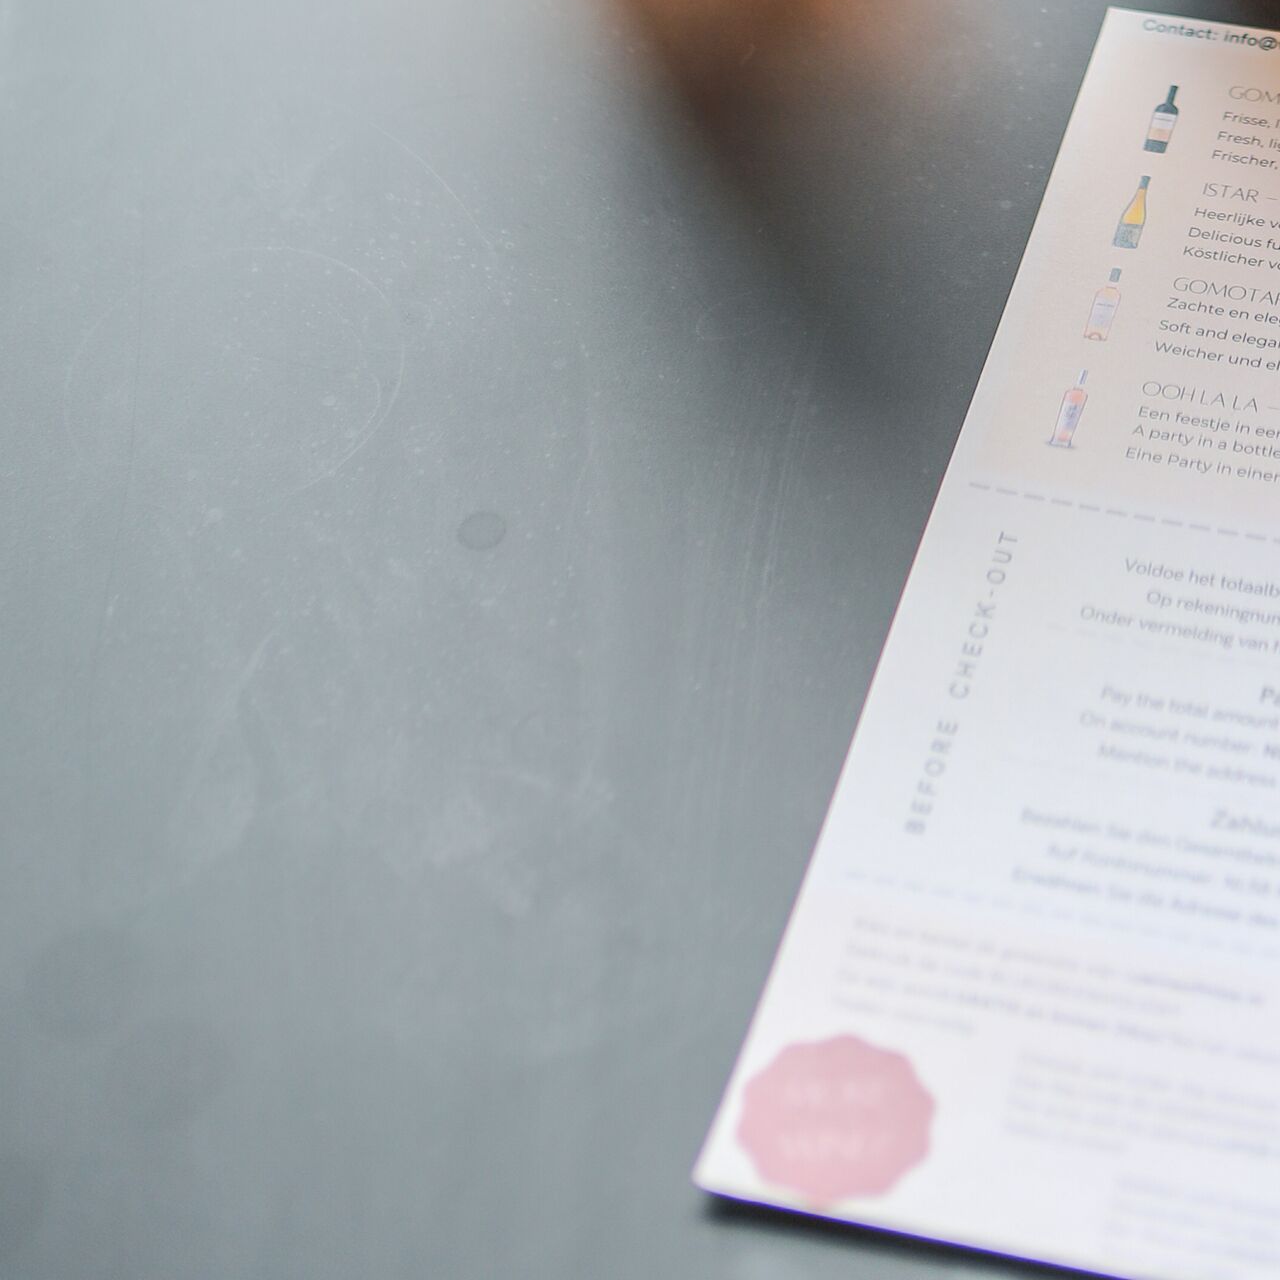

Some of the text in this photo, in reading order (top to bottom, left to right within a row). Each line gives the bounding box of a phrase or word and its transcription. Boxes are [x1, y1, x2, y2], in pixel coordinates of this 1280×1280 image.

[1142, 18, 1218, 41] Contact:
[1222, 110, 1270, 128] Frisse,
[1216, 130, 1264, 148] Fresh,
[1201, 182, 1259, 203] ISTAR
[1193, 206, 1265, 227] Heerlijke
[1182, 245, 1264, 267] Köstlicher
[1158, 319, 1191, 334] Soft
[1194, 327, 1228, 340] and
[1141, 380, 1196, 402] OOH
[1199, 388, 1225, 408] LA
[1231, 394, 1258, 413] LA
[903, 530, 1019, 836] BEFORE CHECK-OUT
